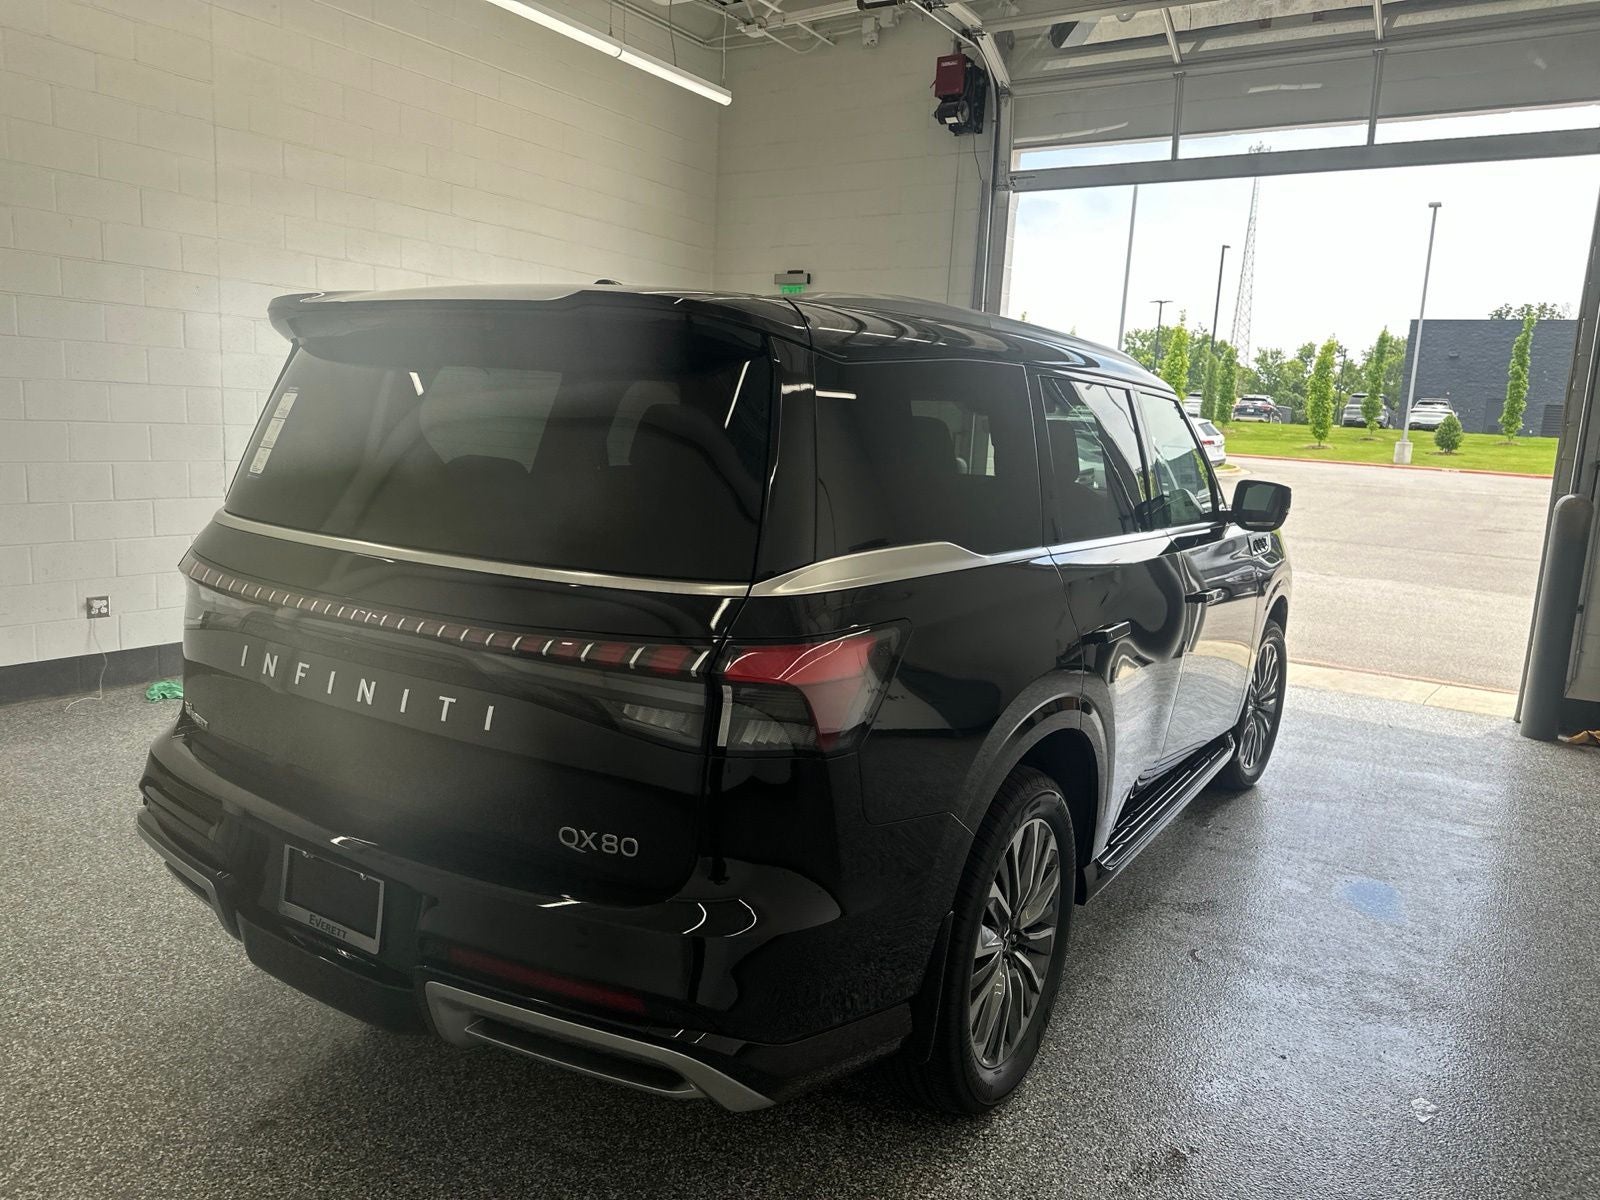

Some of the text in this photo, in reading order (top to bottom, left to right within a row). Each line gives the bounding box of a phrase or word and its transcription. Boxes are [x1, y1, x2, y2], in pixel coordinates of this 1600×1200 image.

[240, 645, 494, 731] INFINITI
[558, 826, 639, 857] QX80
[309, 913, 348, 939] EVERETT
